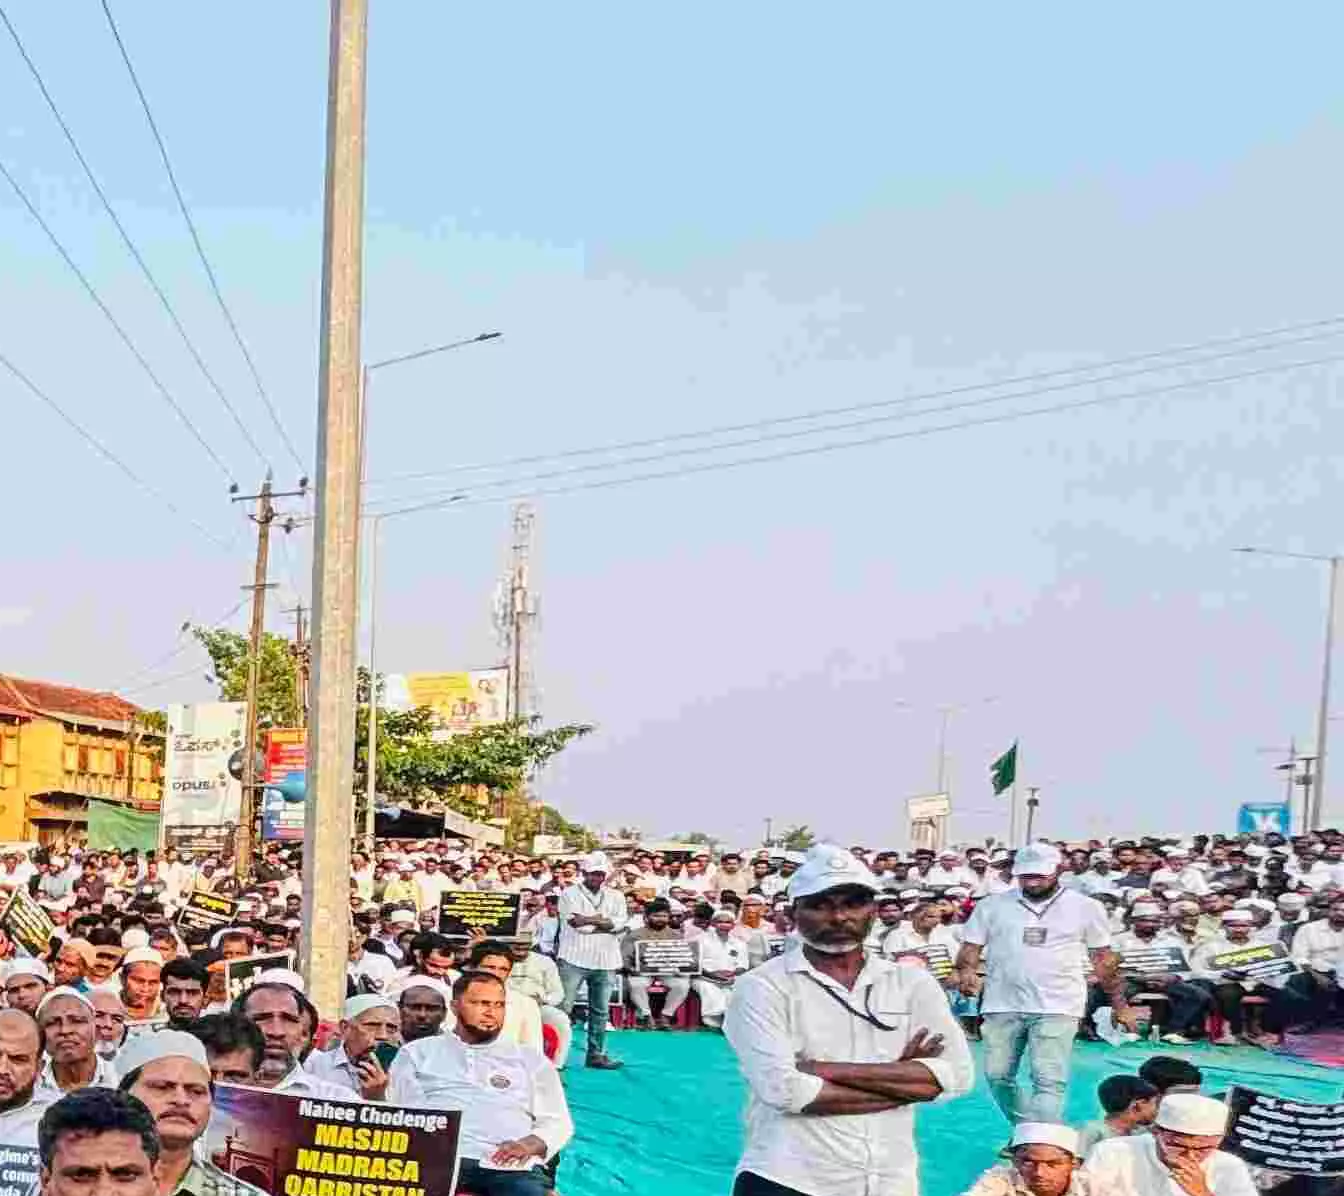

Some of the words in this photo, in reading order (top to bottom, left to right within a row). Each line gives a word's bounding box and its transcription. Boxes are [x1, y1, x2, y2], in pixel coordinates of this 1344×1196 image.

[298, 1099, 356, 1122] Nahee
[359, 1106, 448, 1132] Chodenge
[314, 1123, 410, 1155] MASJID
[297, 1149, 419, 1183] MADRASA
